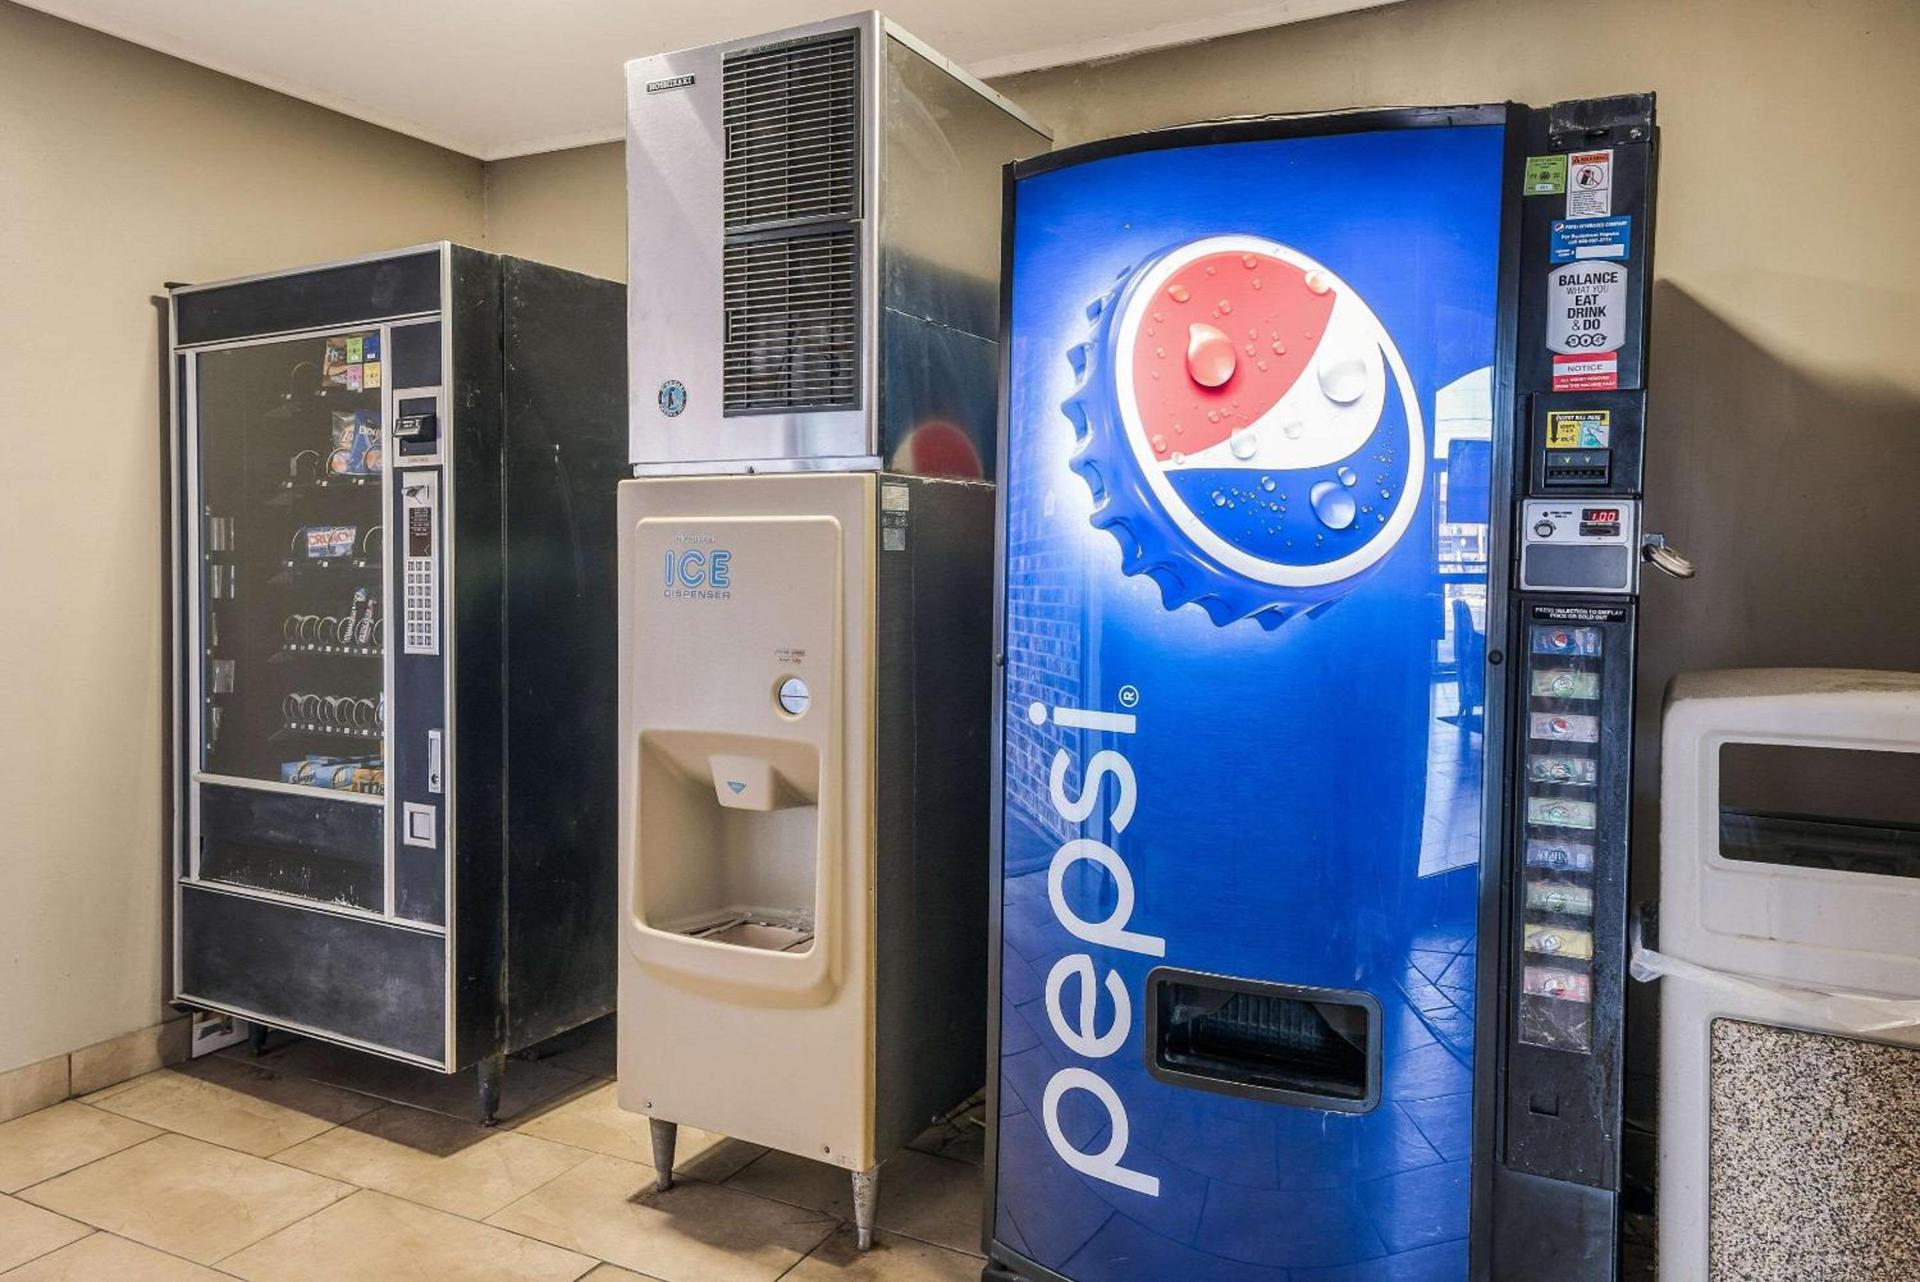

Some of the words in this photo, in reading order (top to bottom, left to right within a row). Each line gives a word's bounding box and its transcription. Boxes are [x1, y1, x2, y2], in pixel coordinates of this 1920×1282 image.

[1558, 272, 1618, 286] BALANCE
[1566, 285, 1589, 295] WHAT
[1592, 284, 1609, 294] YOU
[1575, 294, 1599, 306] EAT
[1567, 305, 1607, 319] DRINK
[1571, 321, 1580, 331] &
[1583, 319, 1601, 330] DO
[1567, 364, 1603, 373] NOTICE
[1591, 512, 1616, 522] 1.00
[665, 549, 731, 588] ICE
[664, 590, 730, 599] DISPENSER
[1029, 701, 1166, 1197] pepsi
